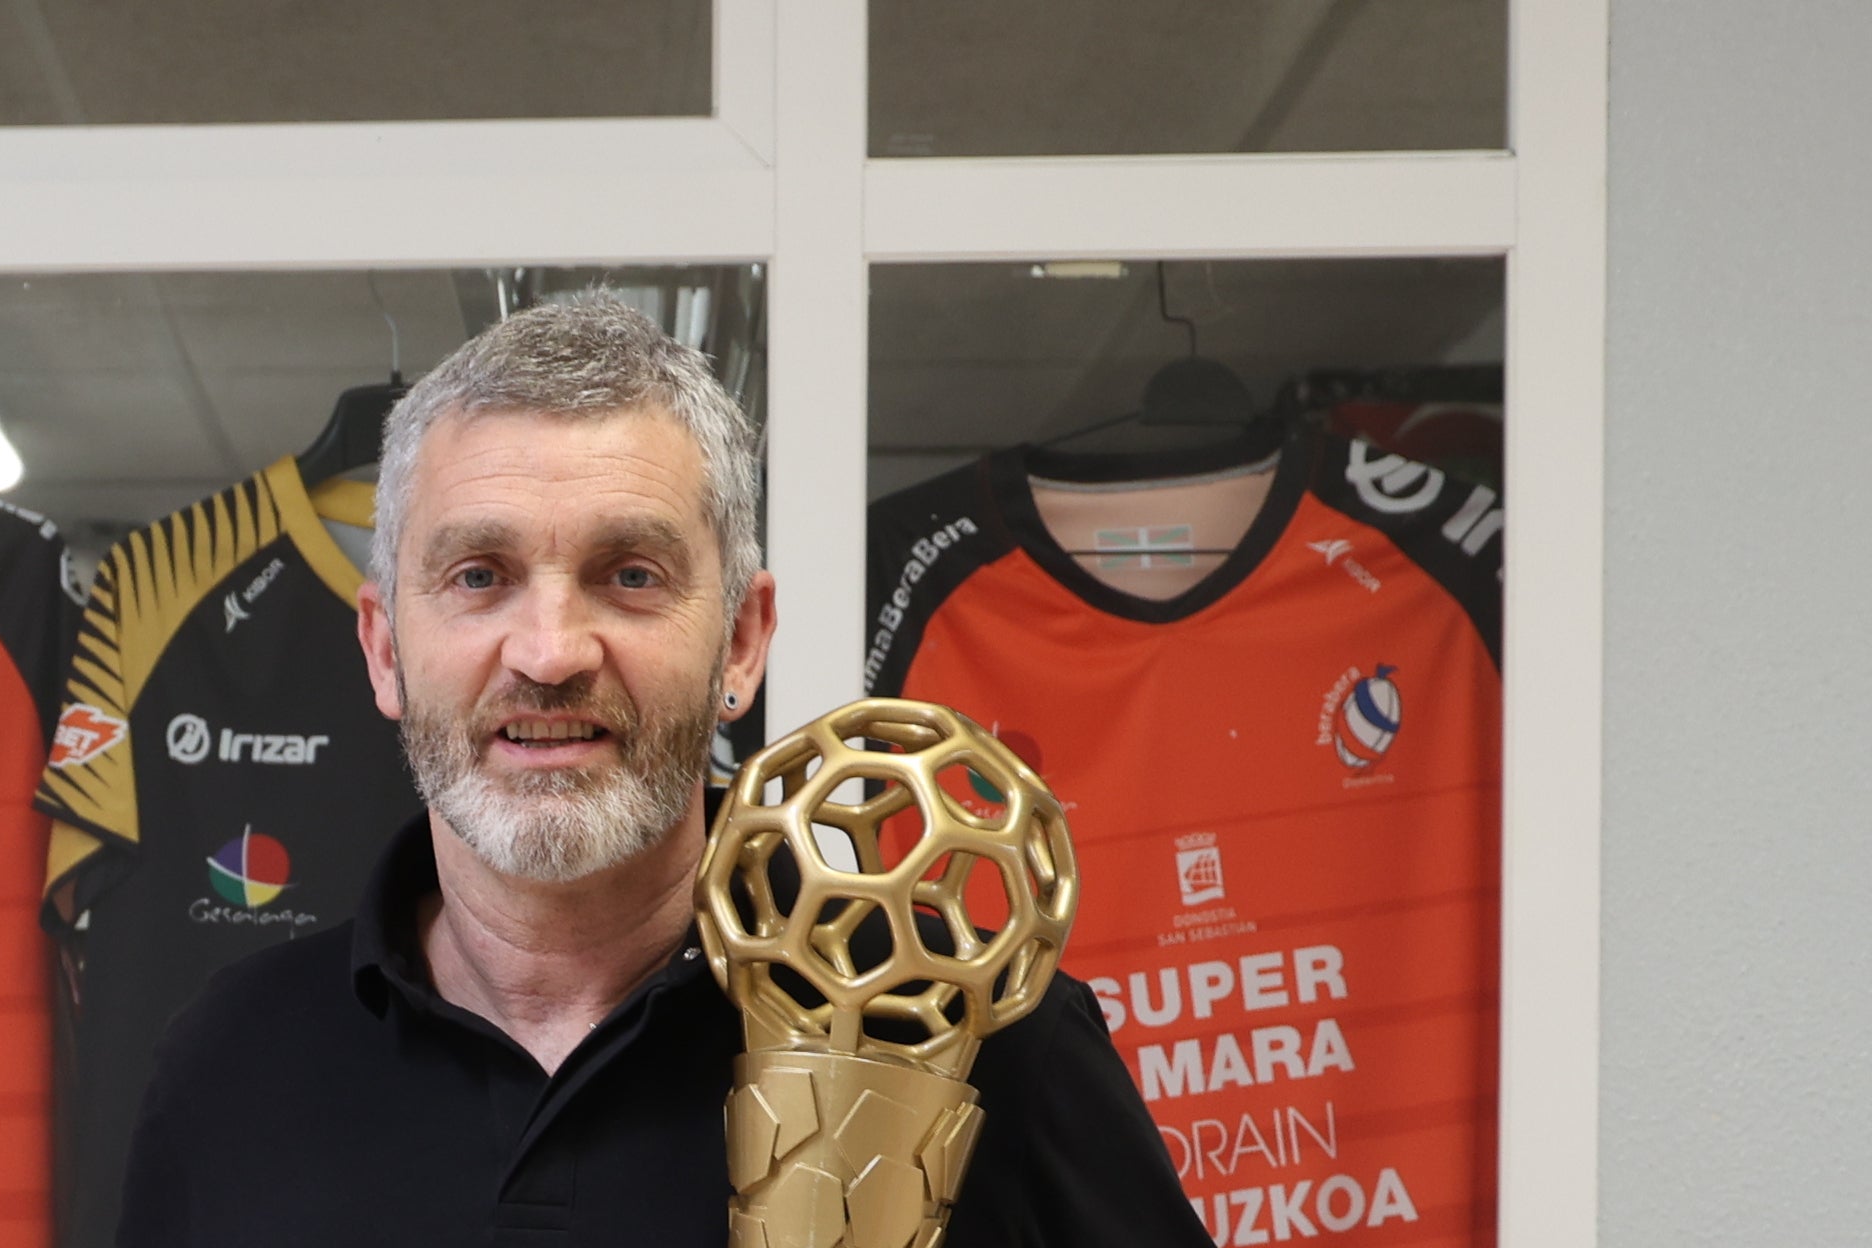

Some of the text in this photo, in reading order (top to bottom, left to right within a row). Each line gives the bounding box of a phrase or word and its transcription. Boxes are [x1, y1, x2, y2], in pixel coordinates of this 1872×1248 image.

[243, 558, 284, 603] KIBOR
[219, 728, 330, 764] Irizar
[1088, 945, 1348, 1034] SUPER
